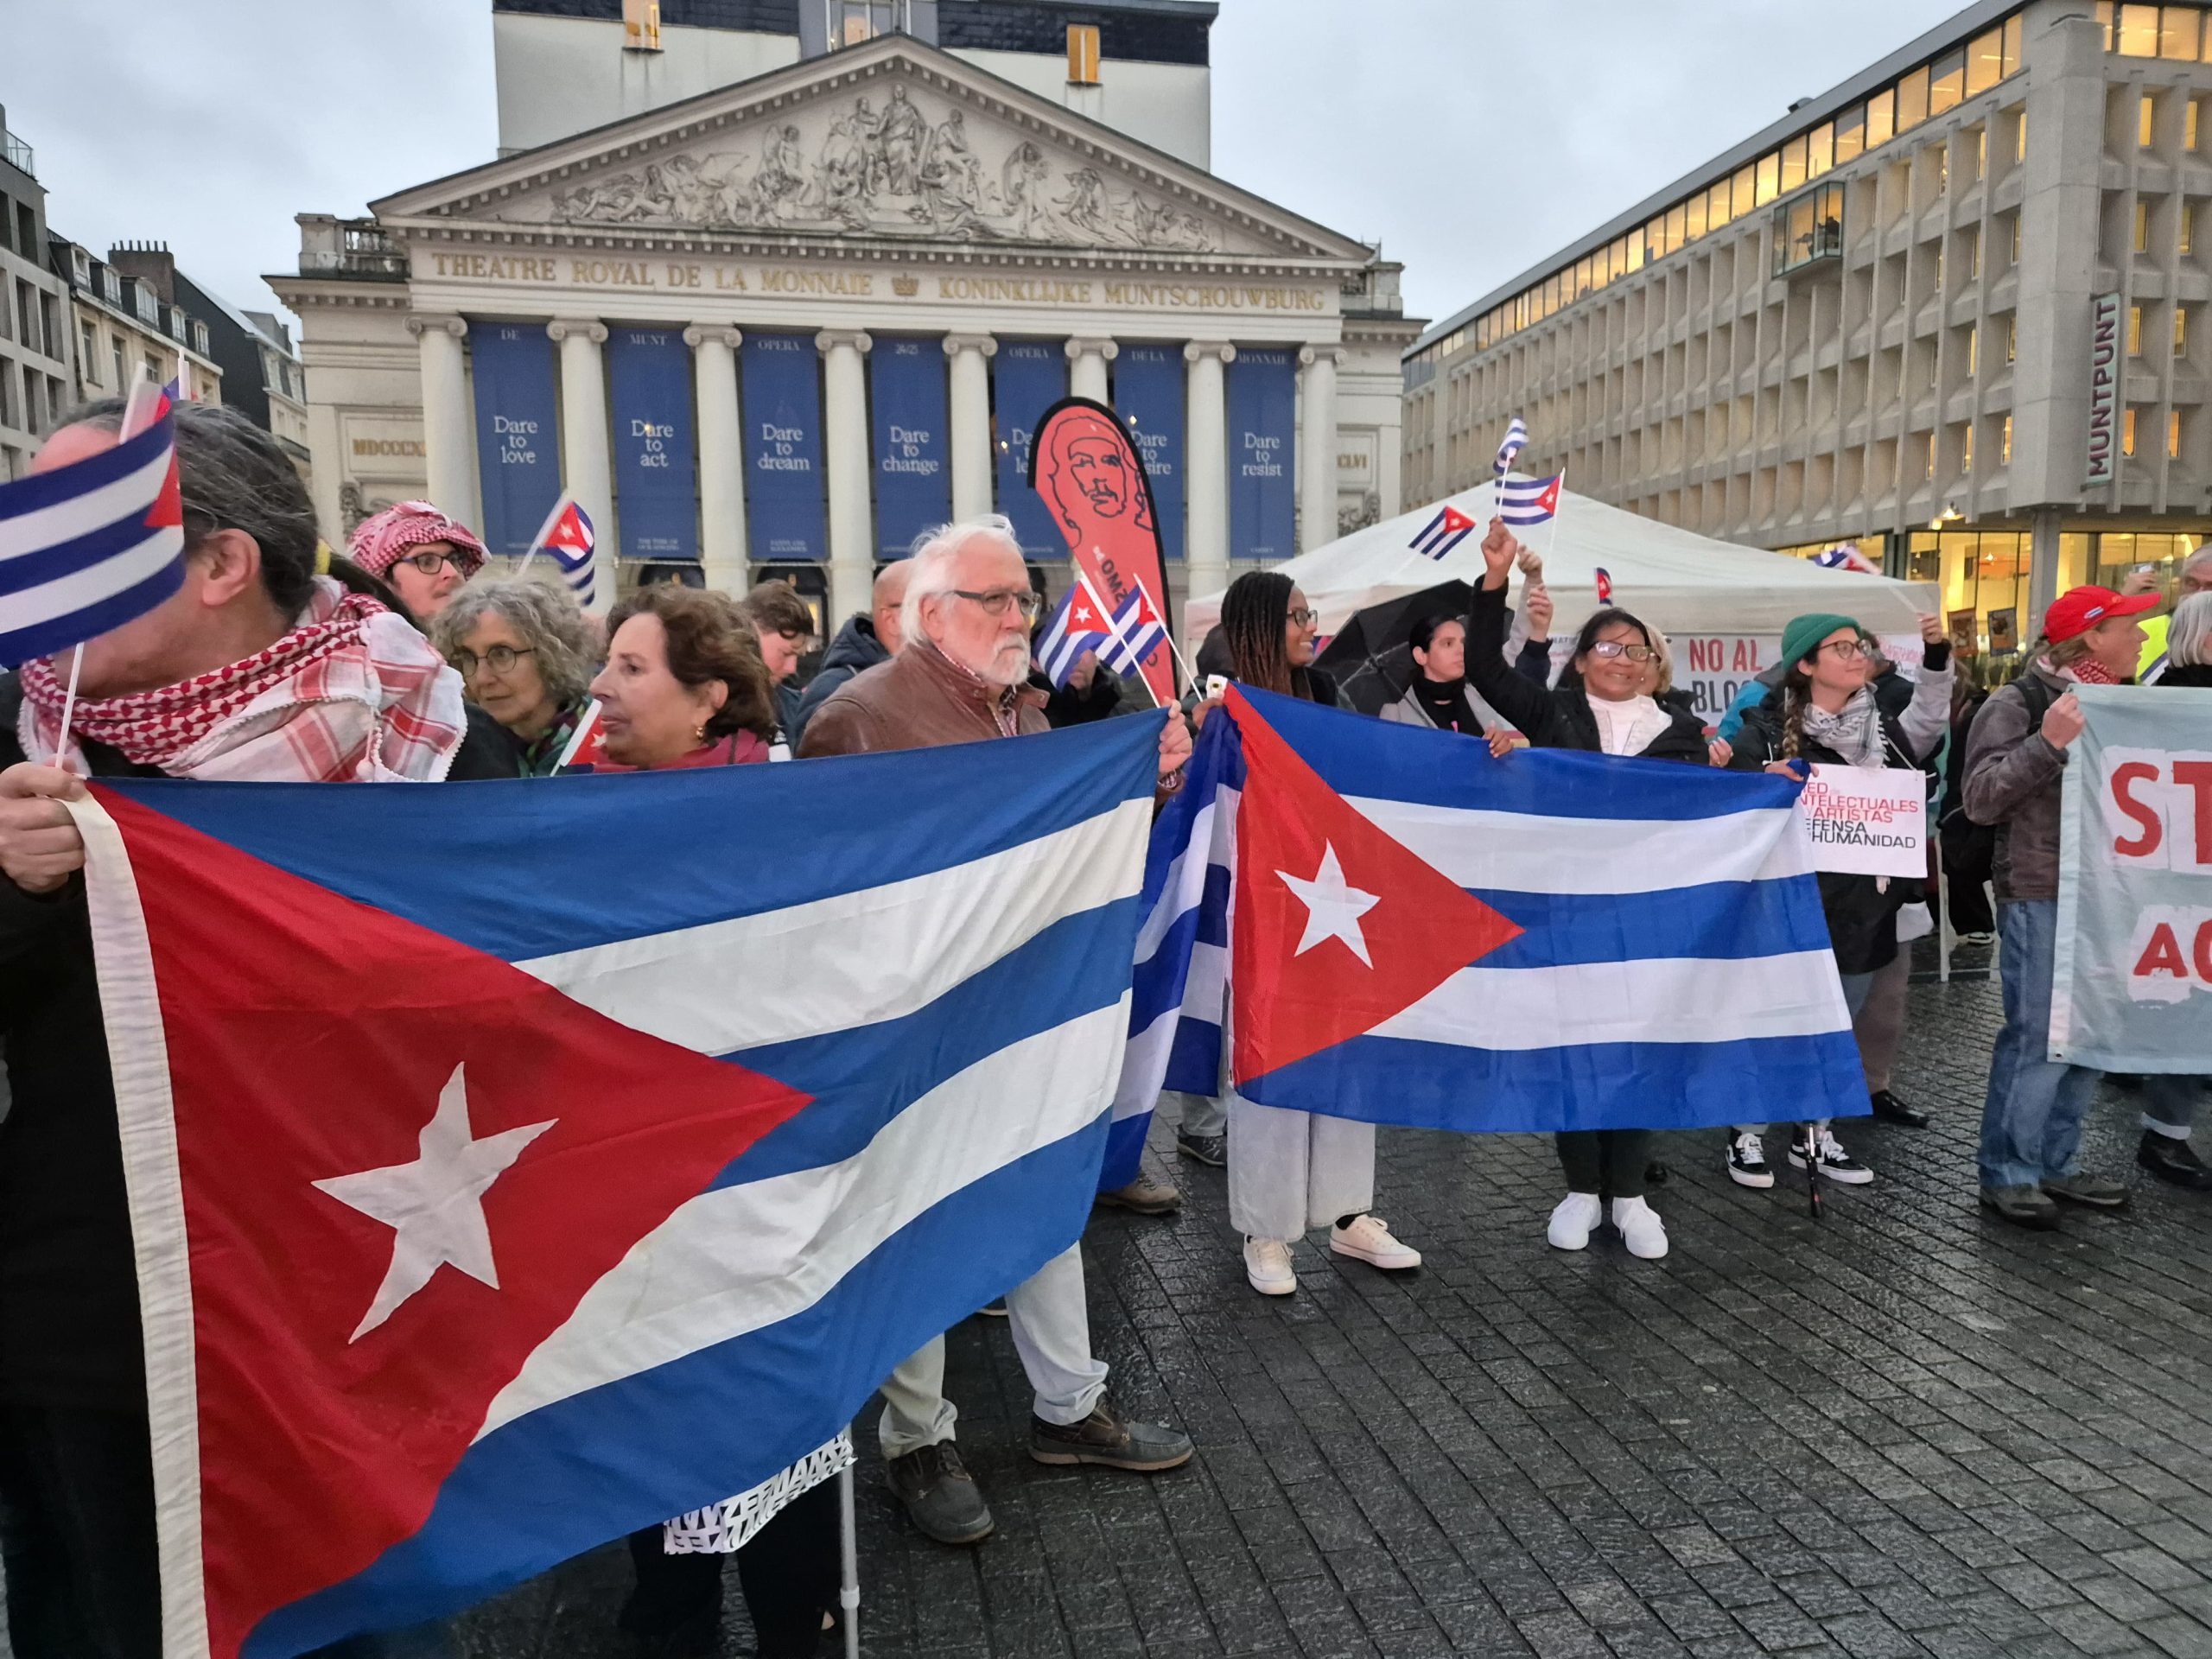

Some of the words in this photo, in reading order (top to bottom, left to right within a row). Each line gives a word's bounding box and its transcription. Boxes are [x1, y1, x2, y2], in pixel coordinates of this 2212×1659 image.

[432, 253, 556, 281] THEATRE
[571, 261, 655, 286] ROYAL
[666, 264, 702, 288] DE
[715, 267, 747, 290] LA
[760, 270, 873, 296] MONNAIE
[938, 277, 1092, 302] KONINKLIJKE
[1104, 283, 1325, 311] MUNTSCHOUWBURG
[500, 328, 519, 340] DE
[630, 334, 668, 346] MUNT
[2088, 302, 2116, 476] MUNTPUNT
[494, 416, 538, 434] Dare
[632, 420, 674, 438] Dare
[762, 423, 803, 442] Dare
[509, 434, 527, 448] to
[890, 426, 930, 443] Dare
[1131, 431, 1167, 447] Dare
[1244, 432, 1281, 449] Dare
[645, 438, 663, 451] to
[776, 442, 792, 455] to
[903, 443, 918, 457] to
[501, 446, 537, 464] love
[640, 454, 669, 467] act
[758, 453, 810, 470] dream
[1142, 448, 1158, 461] to
[1255, 449, 1271, 462] to
[882, 456, 939, 474] change
[1145, 462, 1172, 474] sire
[1243, 463, 1282, 476] resist
[1689, 639, 1724, 672] NO
[1732, 639, 1763, 671] AL
[1692, 680, 1752, 713] BLO
[1804, 782, 1828, 794] ED
[1814, 807, 1893, 823] ARTISTAS
[1812, 831, 1916, 849] HUMANIDAD
